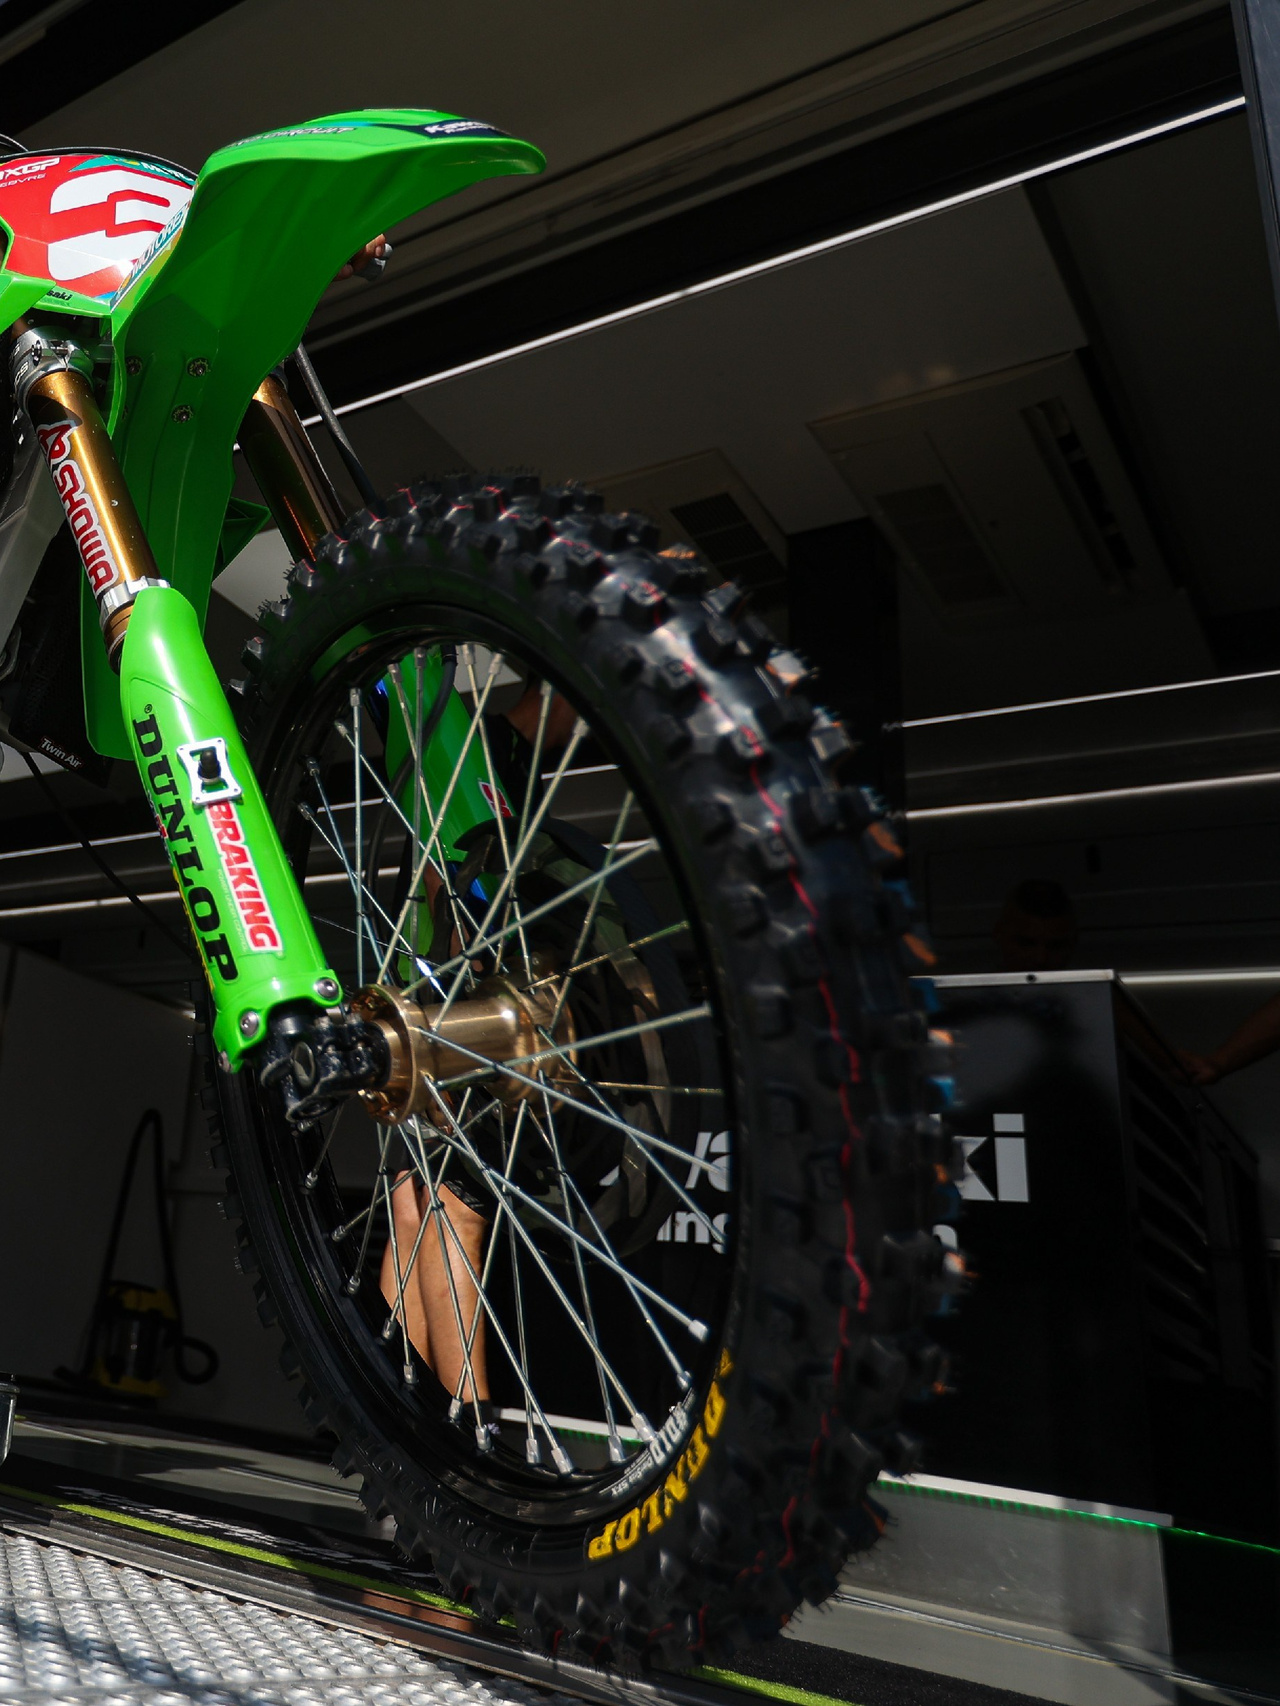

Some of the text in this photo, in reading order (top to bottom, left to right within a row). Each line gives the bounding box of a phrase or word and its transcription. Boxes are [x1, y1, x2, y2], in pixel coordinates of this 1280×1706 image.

[48, 169, 195, 281] 3
[52, 460, 117, 598] SHOWA
[40, 737, 82, 769] Twin Air
[133, 713, 239, 982] DUNLOP
[206, 799, 281, 951] BRAKING
[587, 1380, 727, 1561] DUNLOP
